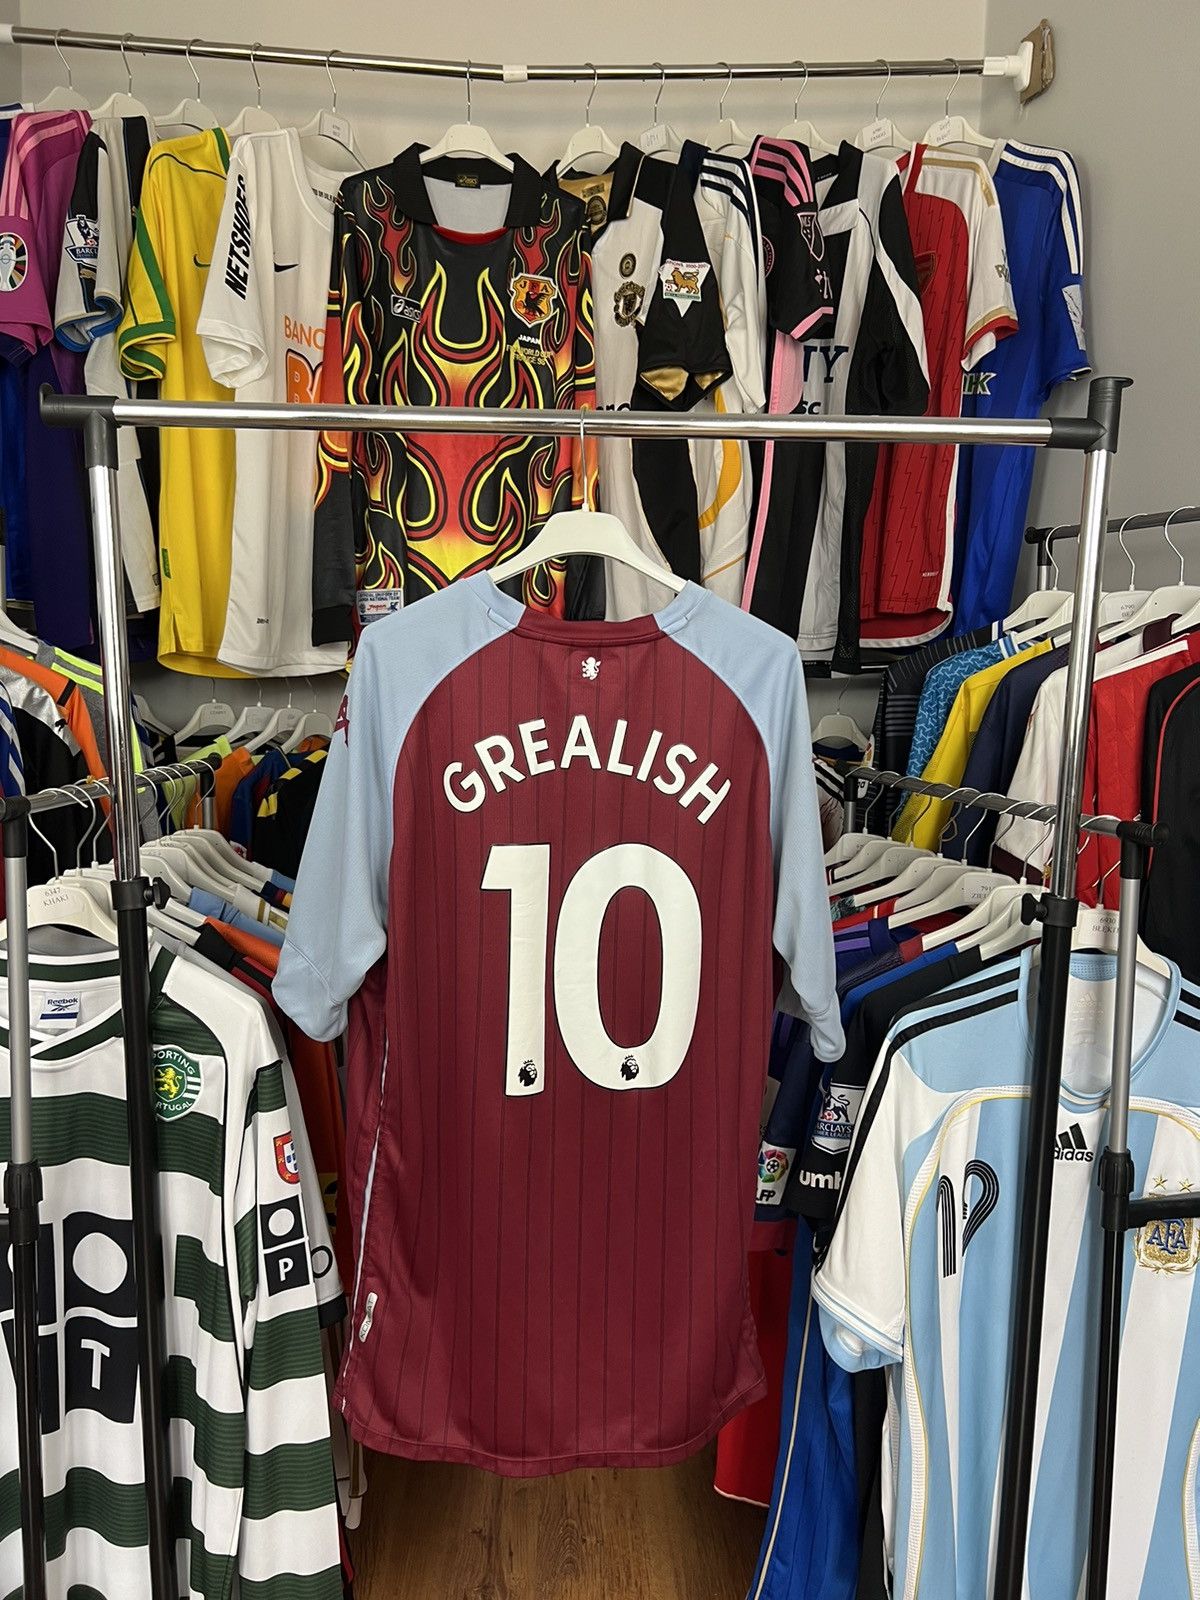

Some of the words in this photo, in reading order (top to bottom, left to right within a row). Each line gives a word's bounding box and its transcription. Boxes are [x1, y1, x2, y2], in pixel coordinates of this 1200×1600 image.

[518, 334, 541, 345] JAPAN
[443, 714, 732, 825] GREALISH
[43, 894, 69, 906] KHAKI
[480, 843, 703, 1097] 10
[47, 997, 78, 1005] Reebok
[153, 1050, 196, 1075] ORTING
[155, 1100, 193, 1112] RTUGAL
[816, 1122, 852, 1134] RCLAYS
[1054, 1147, 1094, 1162] didas
[756, 1189, 776, 1203] FP
[1146, 1218, 1188, 1254] AFA
[278, 1257, 294, 1282] P
[81, 1339, 110, 1390] T
